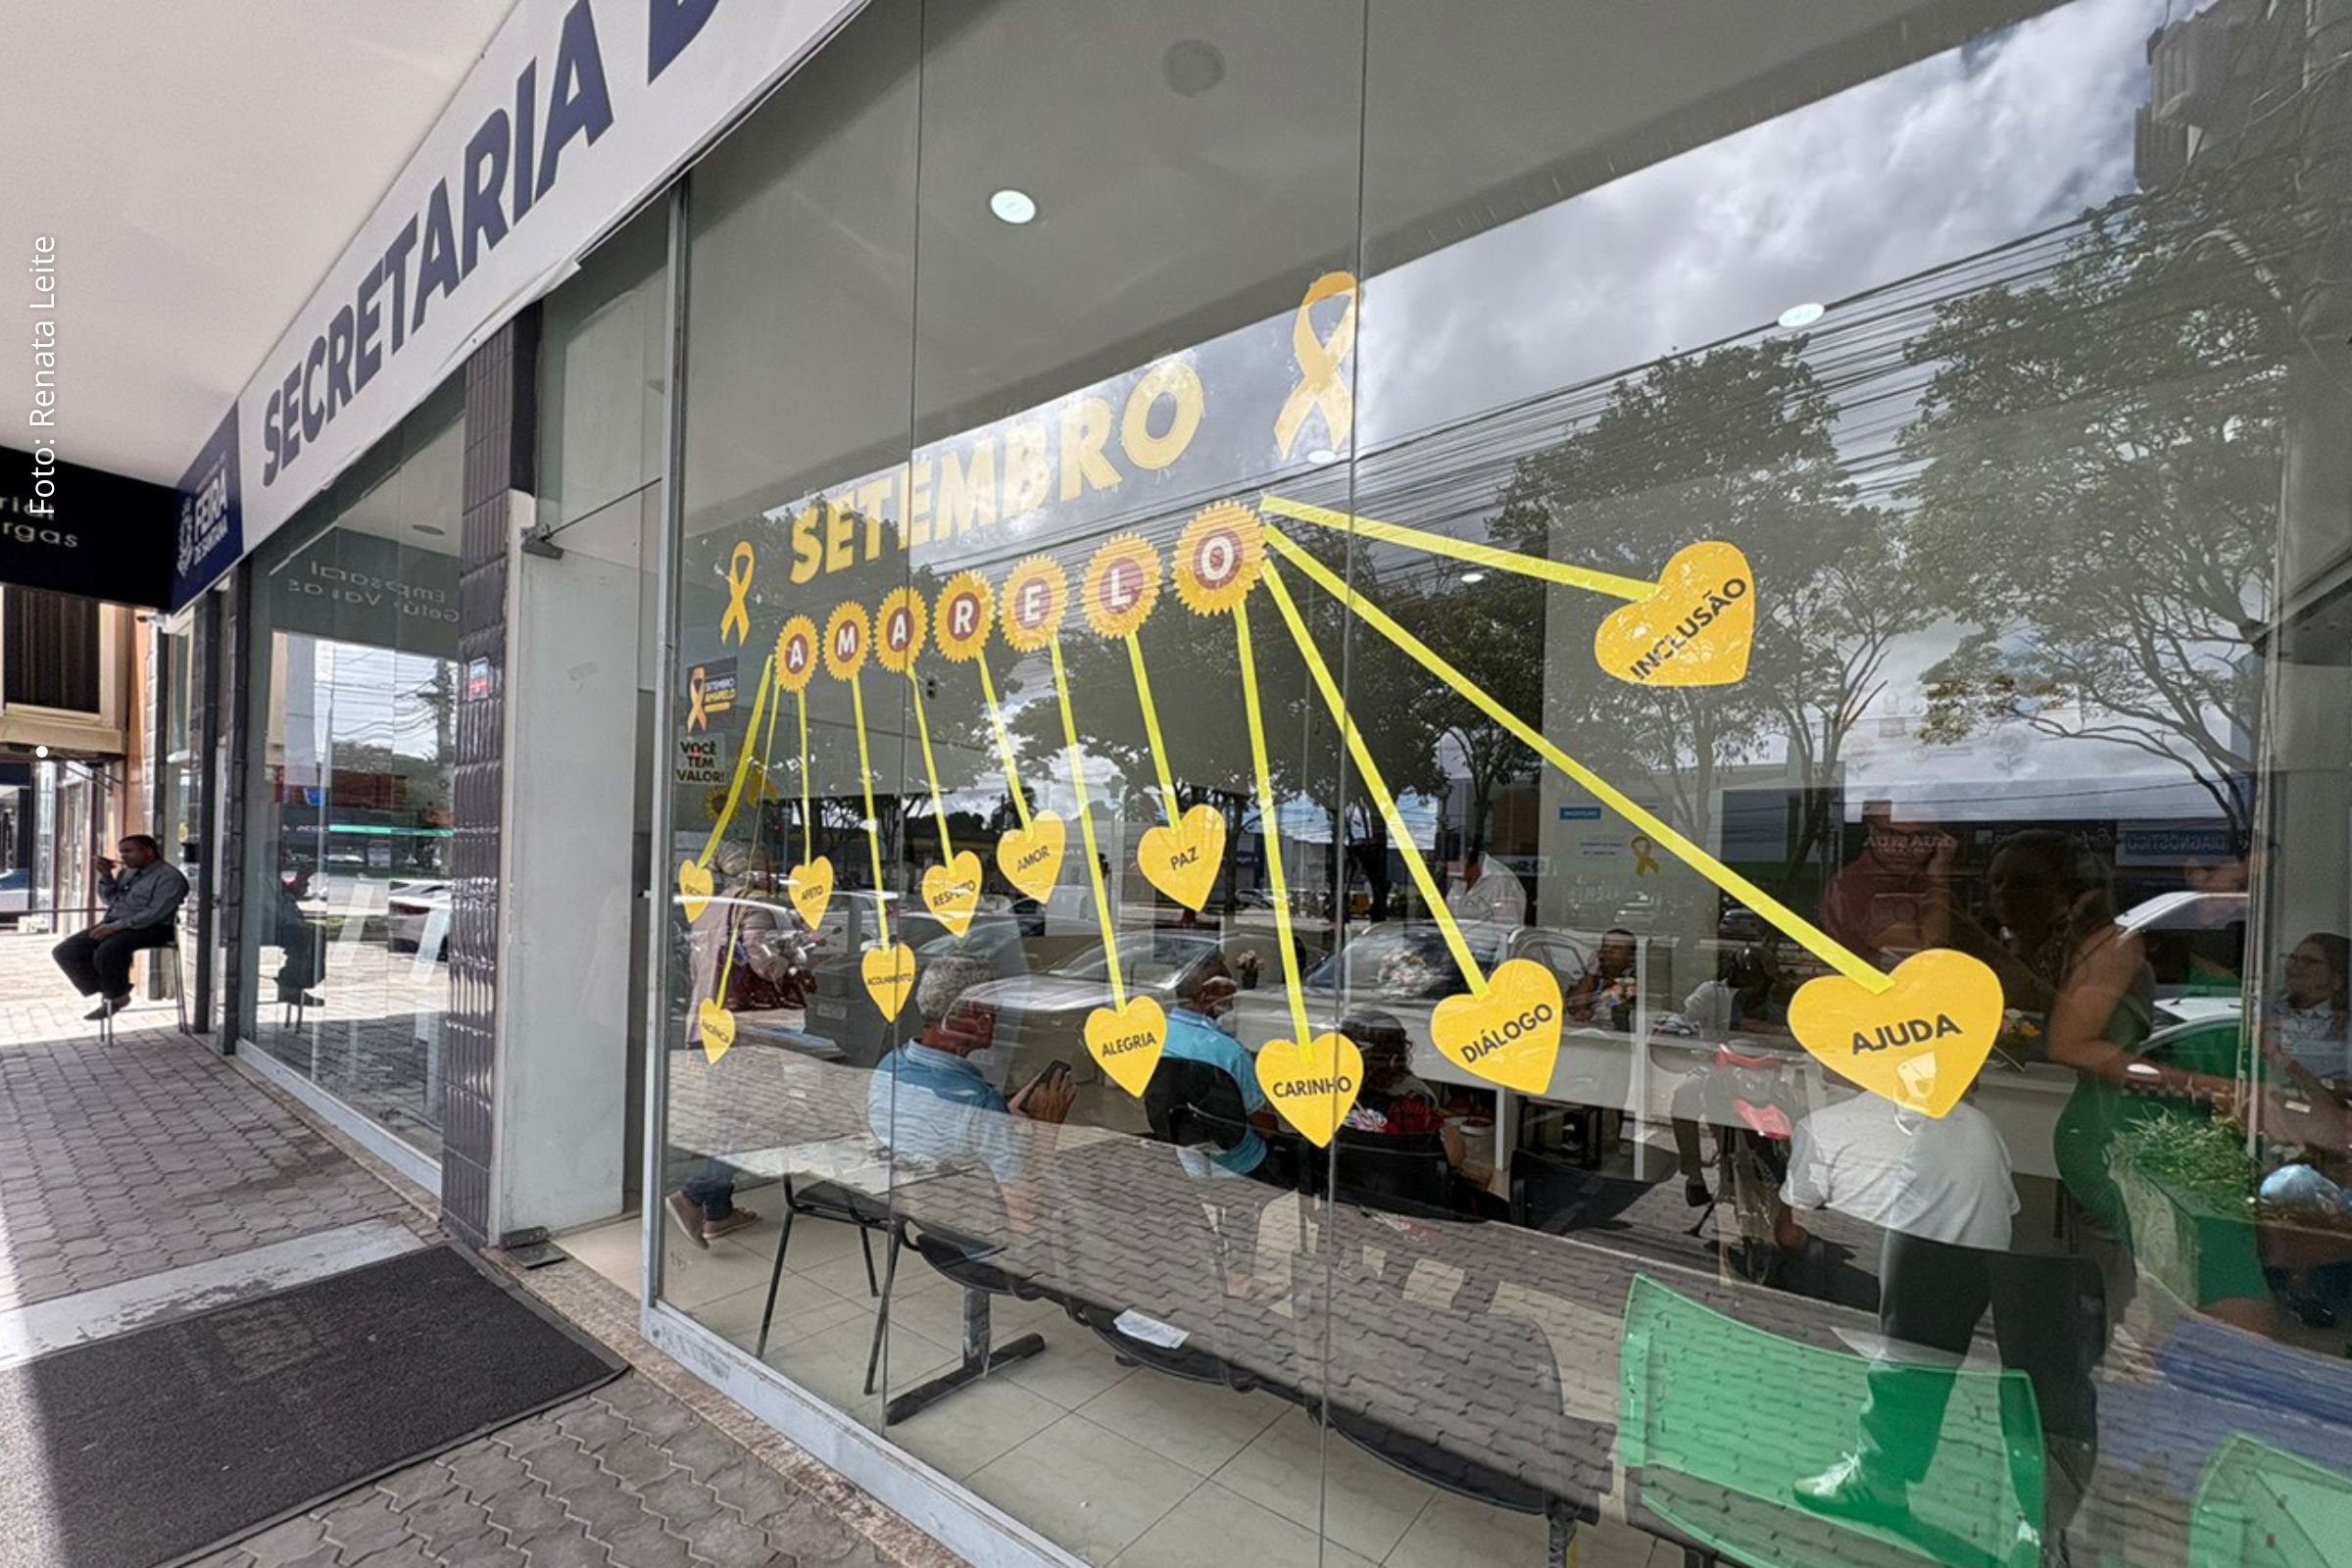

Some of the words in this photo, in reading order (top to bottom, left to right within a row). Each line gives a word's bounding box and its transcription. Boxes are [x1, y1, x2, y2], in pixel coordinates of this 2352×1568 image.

[262, 0, 614, 487] SECRETARIA
[790, 359, 1202, 585] SETEMBRO
[1630, 577, 1747, 682] INCLUSÃO
[687, 756, 714, 768] TEM
[1014, 845, 1051, 873] AMOR
[1170, 847, 1201, 871] PAZ
[1102, 1030, 1157, 1056] ALEGRIA
[1461, 1003, 1553, 1064] DIÁLOGO
[1850, 1012, 1964, 1055] AJUDA
[1273, 1076, 1352, 1099] CARINHO
